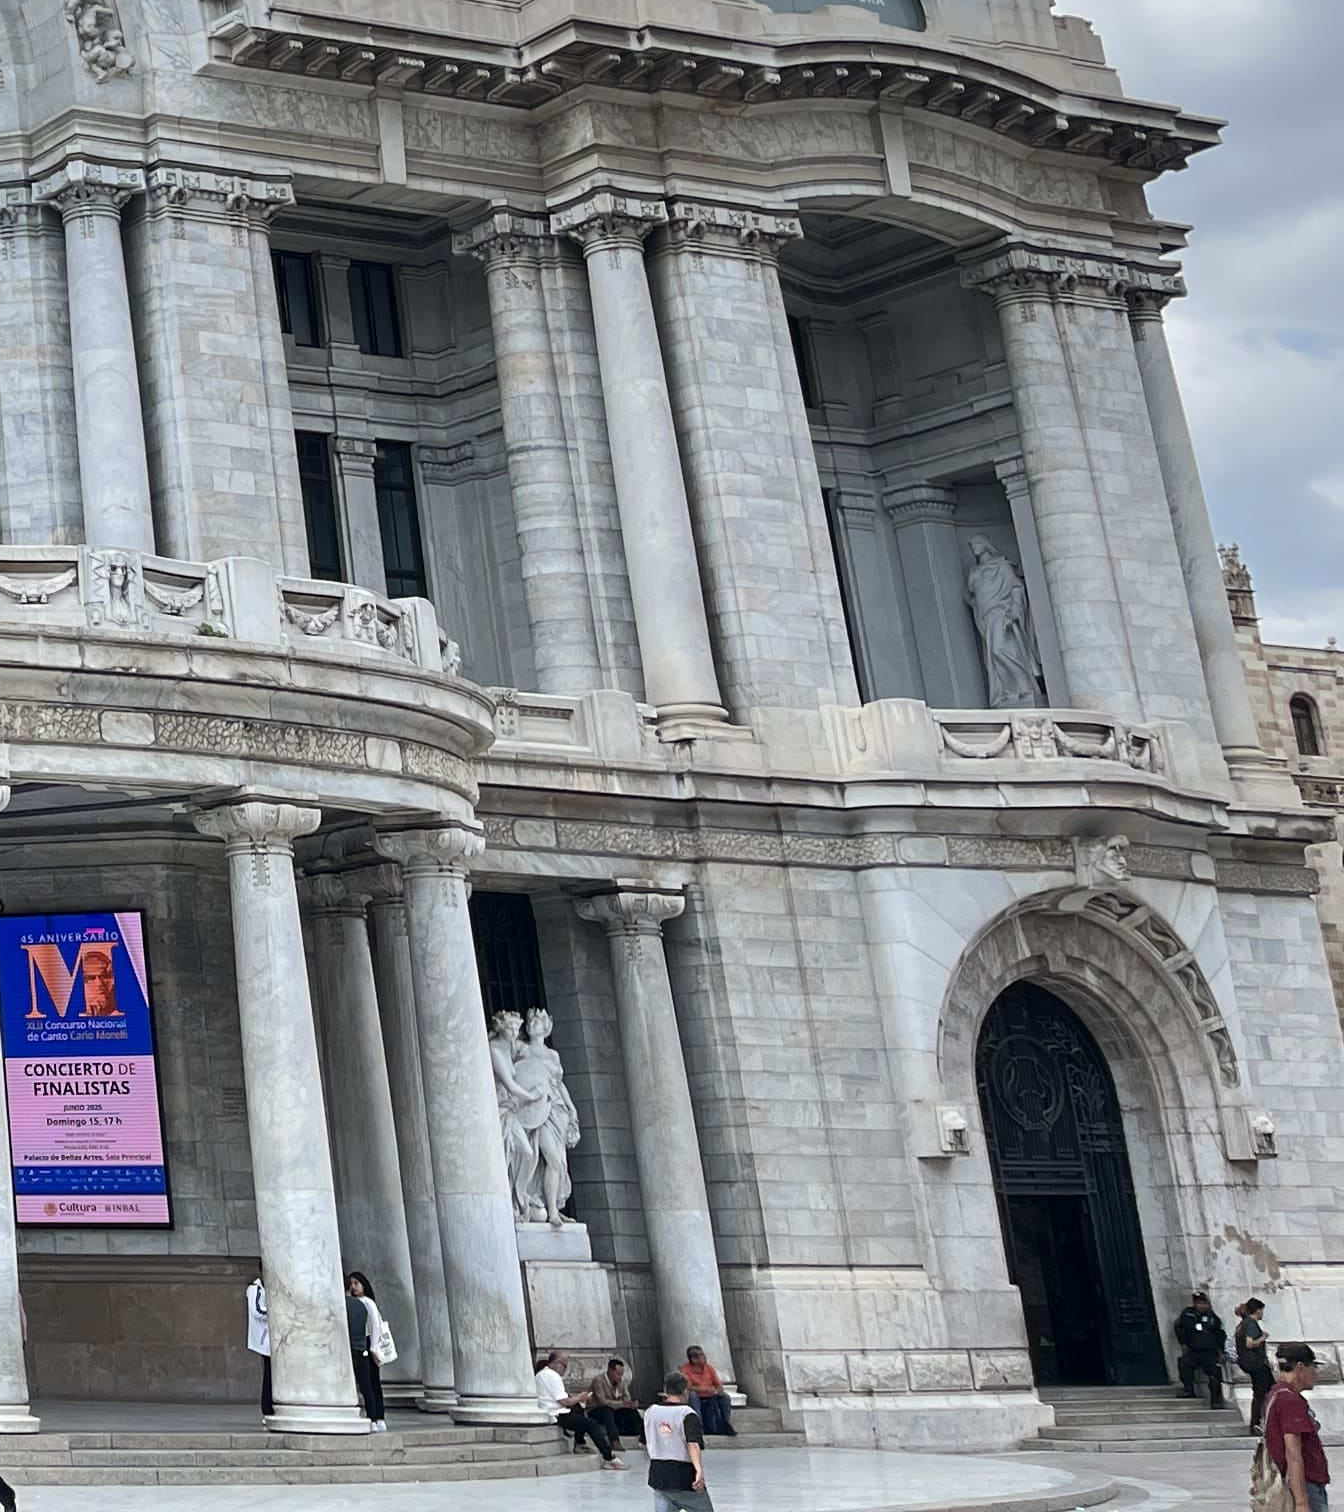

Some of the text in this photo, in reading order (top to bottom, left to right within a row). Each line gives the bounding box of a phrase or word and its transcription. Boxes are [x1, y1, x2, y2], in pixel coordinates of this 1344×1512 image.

[38, 931, 119, 943] ANIVERSARIO
[45, 1020, 86, 1031] Concurso
[88, 1018, 127, 1030] Nacional
[27, 1032, 39, 1042] de
[40, 1032, 68, 1042] Canto
[24, 1062, 136, 1077] CONCIERTO DE
[33, 1080, 131, 1097] FINALISTAS
[46, 1117, 87, 1128] Domingo
[105, 1116, 115, 1126] 17
[23, 1154, 49, 1162] Palacio
[61, 1153, 82, 1162] Bellas
[121, 1153, 152, 1162] Principal
[59, 1202, 97, 1213] Cultura
